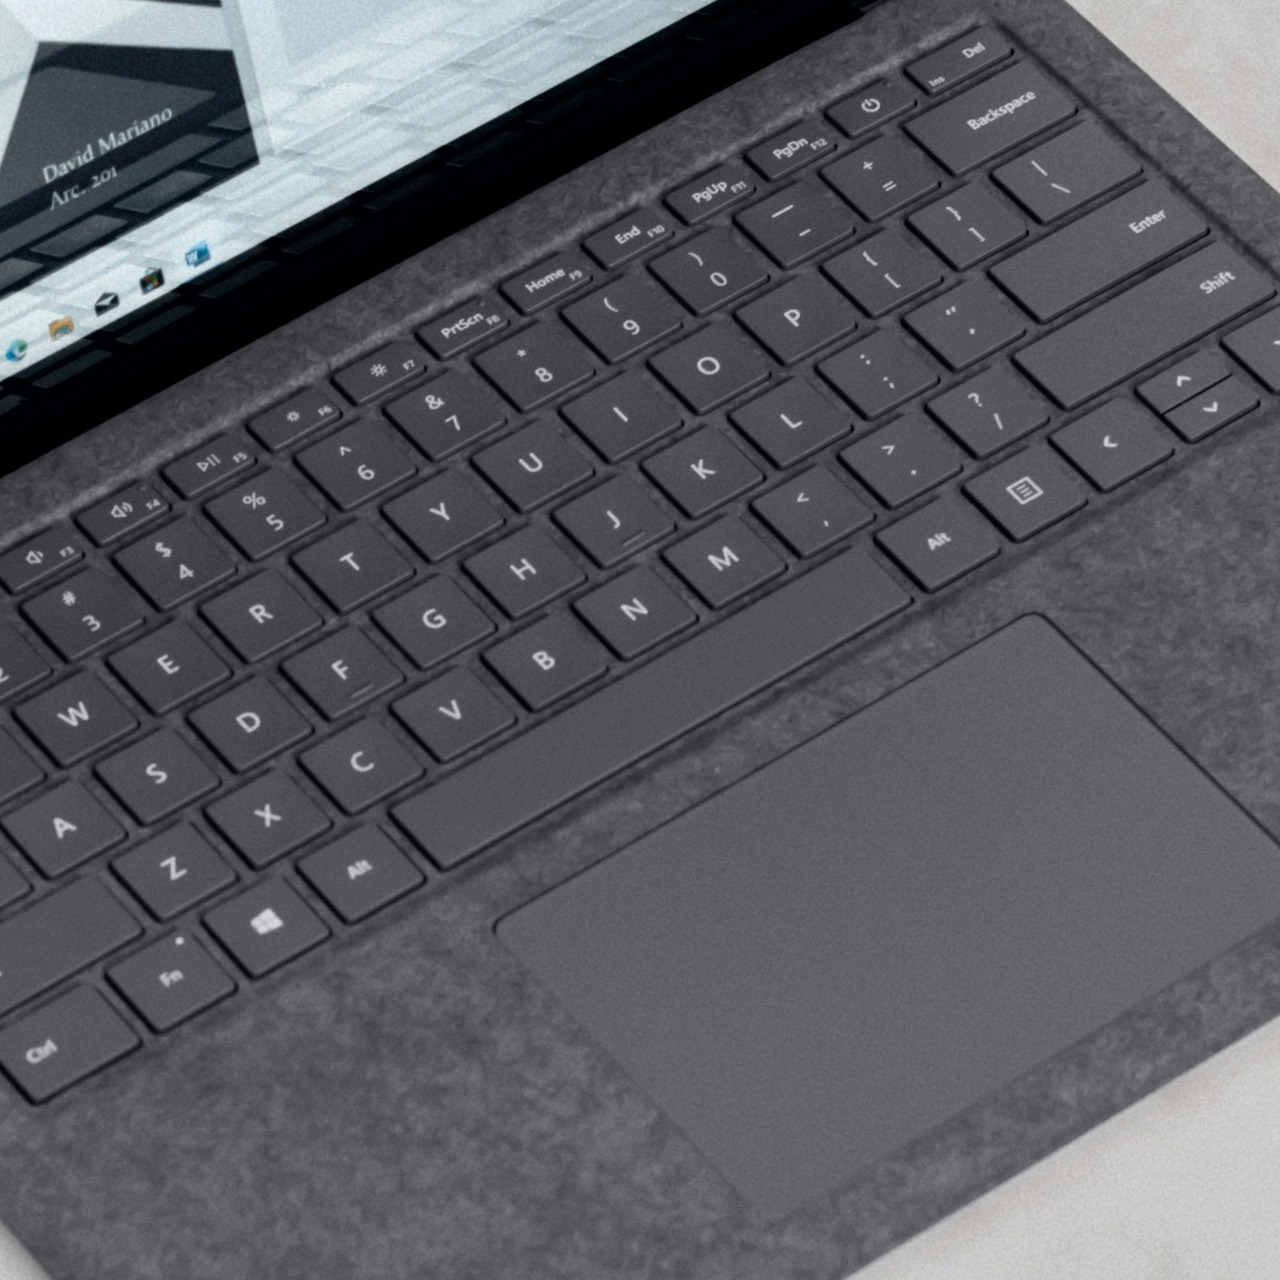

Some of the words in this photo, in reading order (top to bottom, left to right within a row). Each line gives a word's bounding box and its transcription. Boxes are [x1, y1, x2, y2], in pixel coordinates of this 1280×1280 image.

[961, 41, 986, 59] Del
[966, 91, 1036, 131] Backspace
[42, 143, 95, 184] David
[97, 107, 173, 155] Mariano
[772, 138, 815, 160] PgDn
[810, 138, 828, 150] F12
[49, 185, 91, 213] Arc.
[90, 166, 122, 190] 201
[691, 181, 734, 203] PgUp
[730, 180, 747, 193] F11
[646, 224, 665, 238] F10
[1128, 210, 1166, 234] Enter
[614, 225, 642, 244] End
[525, 268, 566, 293] Home
[568, 269, 583, 281] F9
[709, 271, 728, 287] 0
[1199, 271, 1236, 294] Shift
[440, 313, 484, 338] PrtScn
[486, 314, 500, 325] F8
[622, 319, 641, 336] 9
[783, 308, 801, 328] P
[402, 359, 415, 371] F7
[534, 367, 554, 383] 8
[696, 356, 721, 376] O
[317, 405, 333, 417] F6
[612, 406, 629, 423] I
[779, 413, 803, 429] L
[444, 414, 461, 431] 7
[232, 452, 248, 463] F5
[518, 452, 543, 473] U
[357, 464, 376, 481] 6
[690, 458, 716, 480] K
[429, 502, 450, 521] Y
[606, 510, 621, 529] J
[265, 513, 285, 531] 5
[927, 532, 952, 551] Alt
[339, 552, 360, 571] T
[707, 546, 739, 571] M
[179, 563, 194, 580] 4
[509, 558, 537, 581] H
[248, 603, 274, 624] R
[422, 608, 447, 629] G
[620, 598, 649, 621] N
[82, 614, 101, 632] 3
[156, 654, 180, 675] E
[331, 660, 348, 680] F
[532, 650, 556, 671] B
[57, 701, 90, 727] W
[438, 699, 462, 720] V
[235, 711, 261, 733] D
[350, 750, 375, 773] C
[145, 763, 168, 784] S
[254, 804, 282, 828] X
[53, 817, 77, 839] A
[159, 856, 187, 881] Z
[347, 859, 373, 880] Alt
[158, 970, 184, 987] Fn
[25, 1039, 58, 1064] Ctrl
